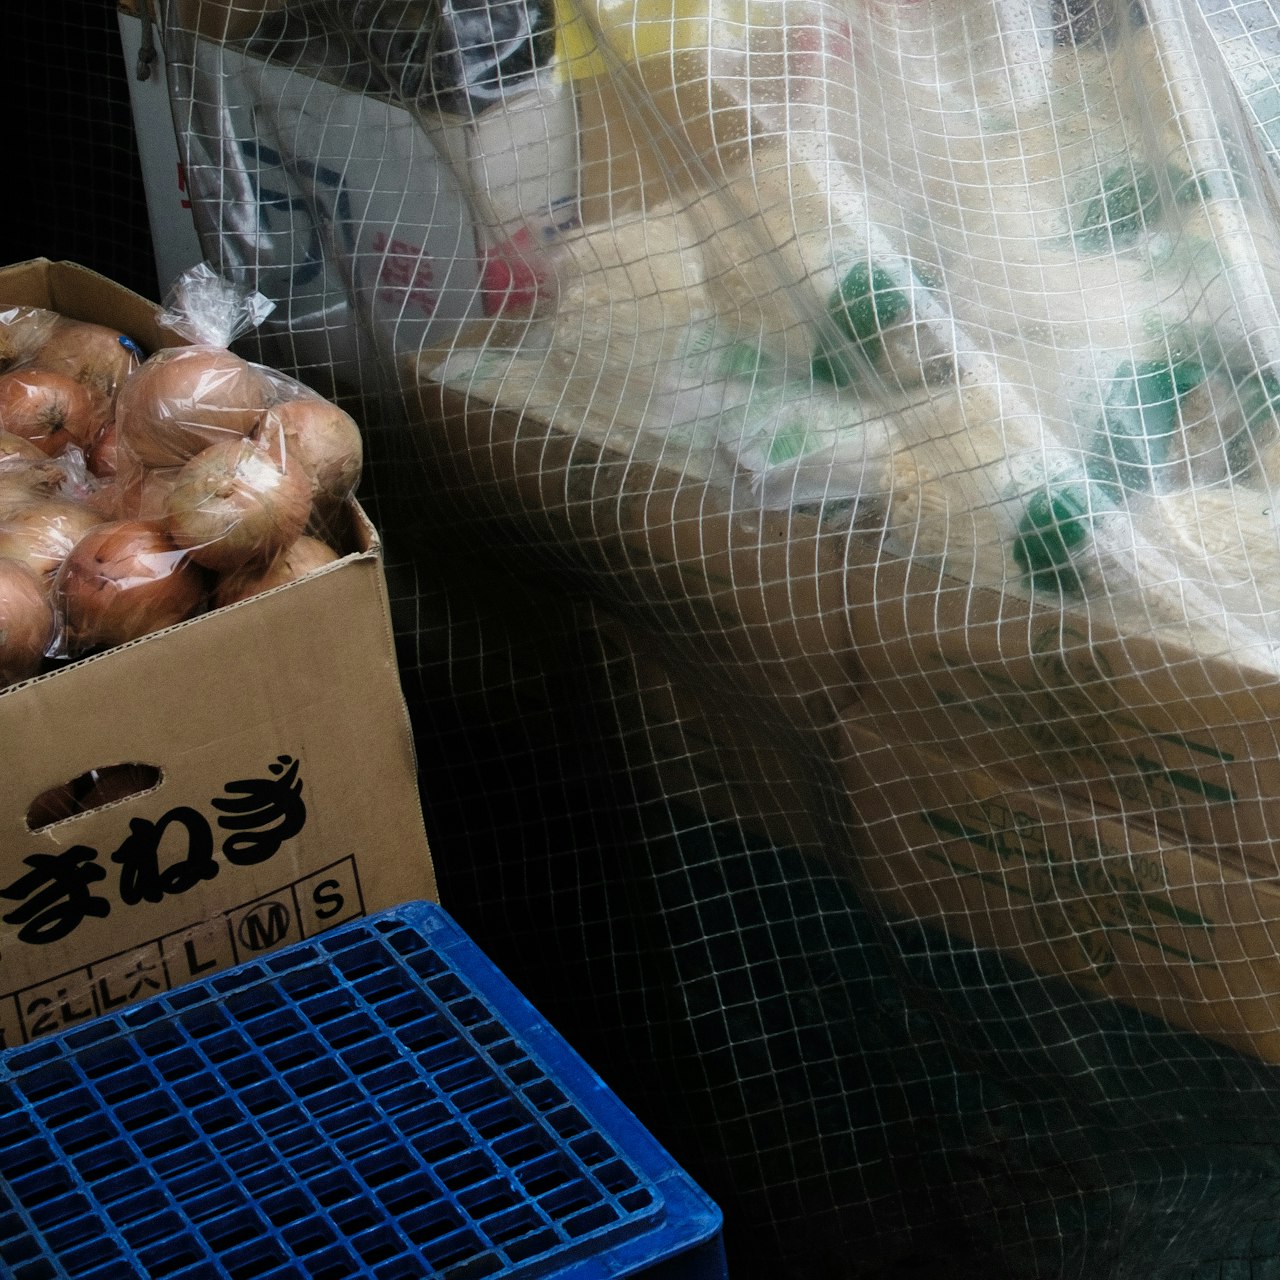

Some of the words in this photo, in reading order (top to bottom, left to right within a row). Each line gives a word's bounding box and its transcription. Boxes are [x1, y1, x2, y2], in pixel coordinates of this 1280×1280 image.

[185, 935, 218, 977] L
[247, 901, 288, 949] M
[313, 878, 345, 920] S
